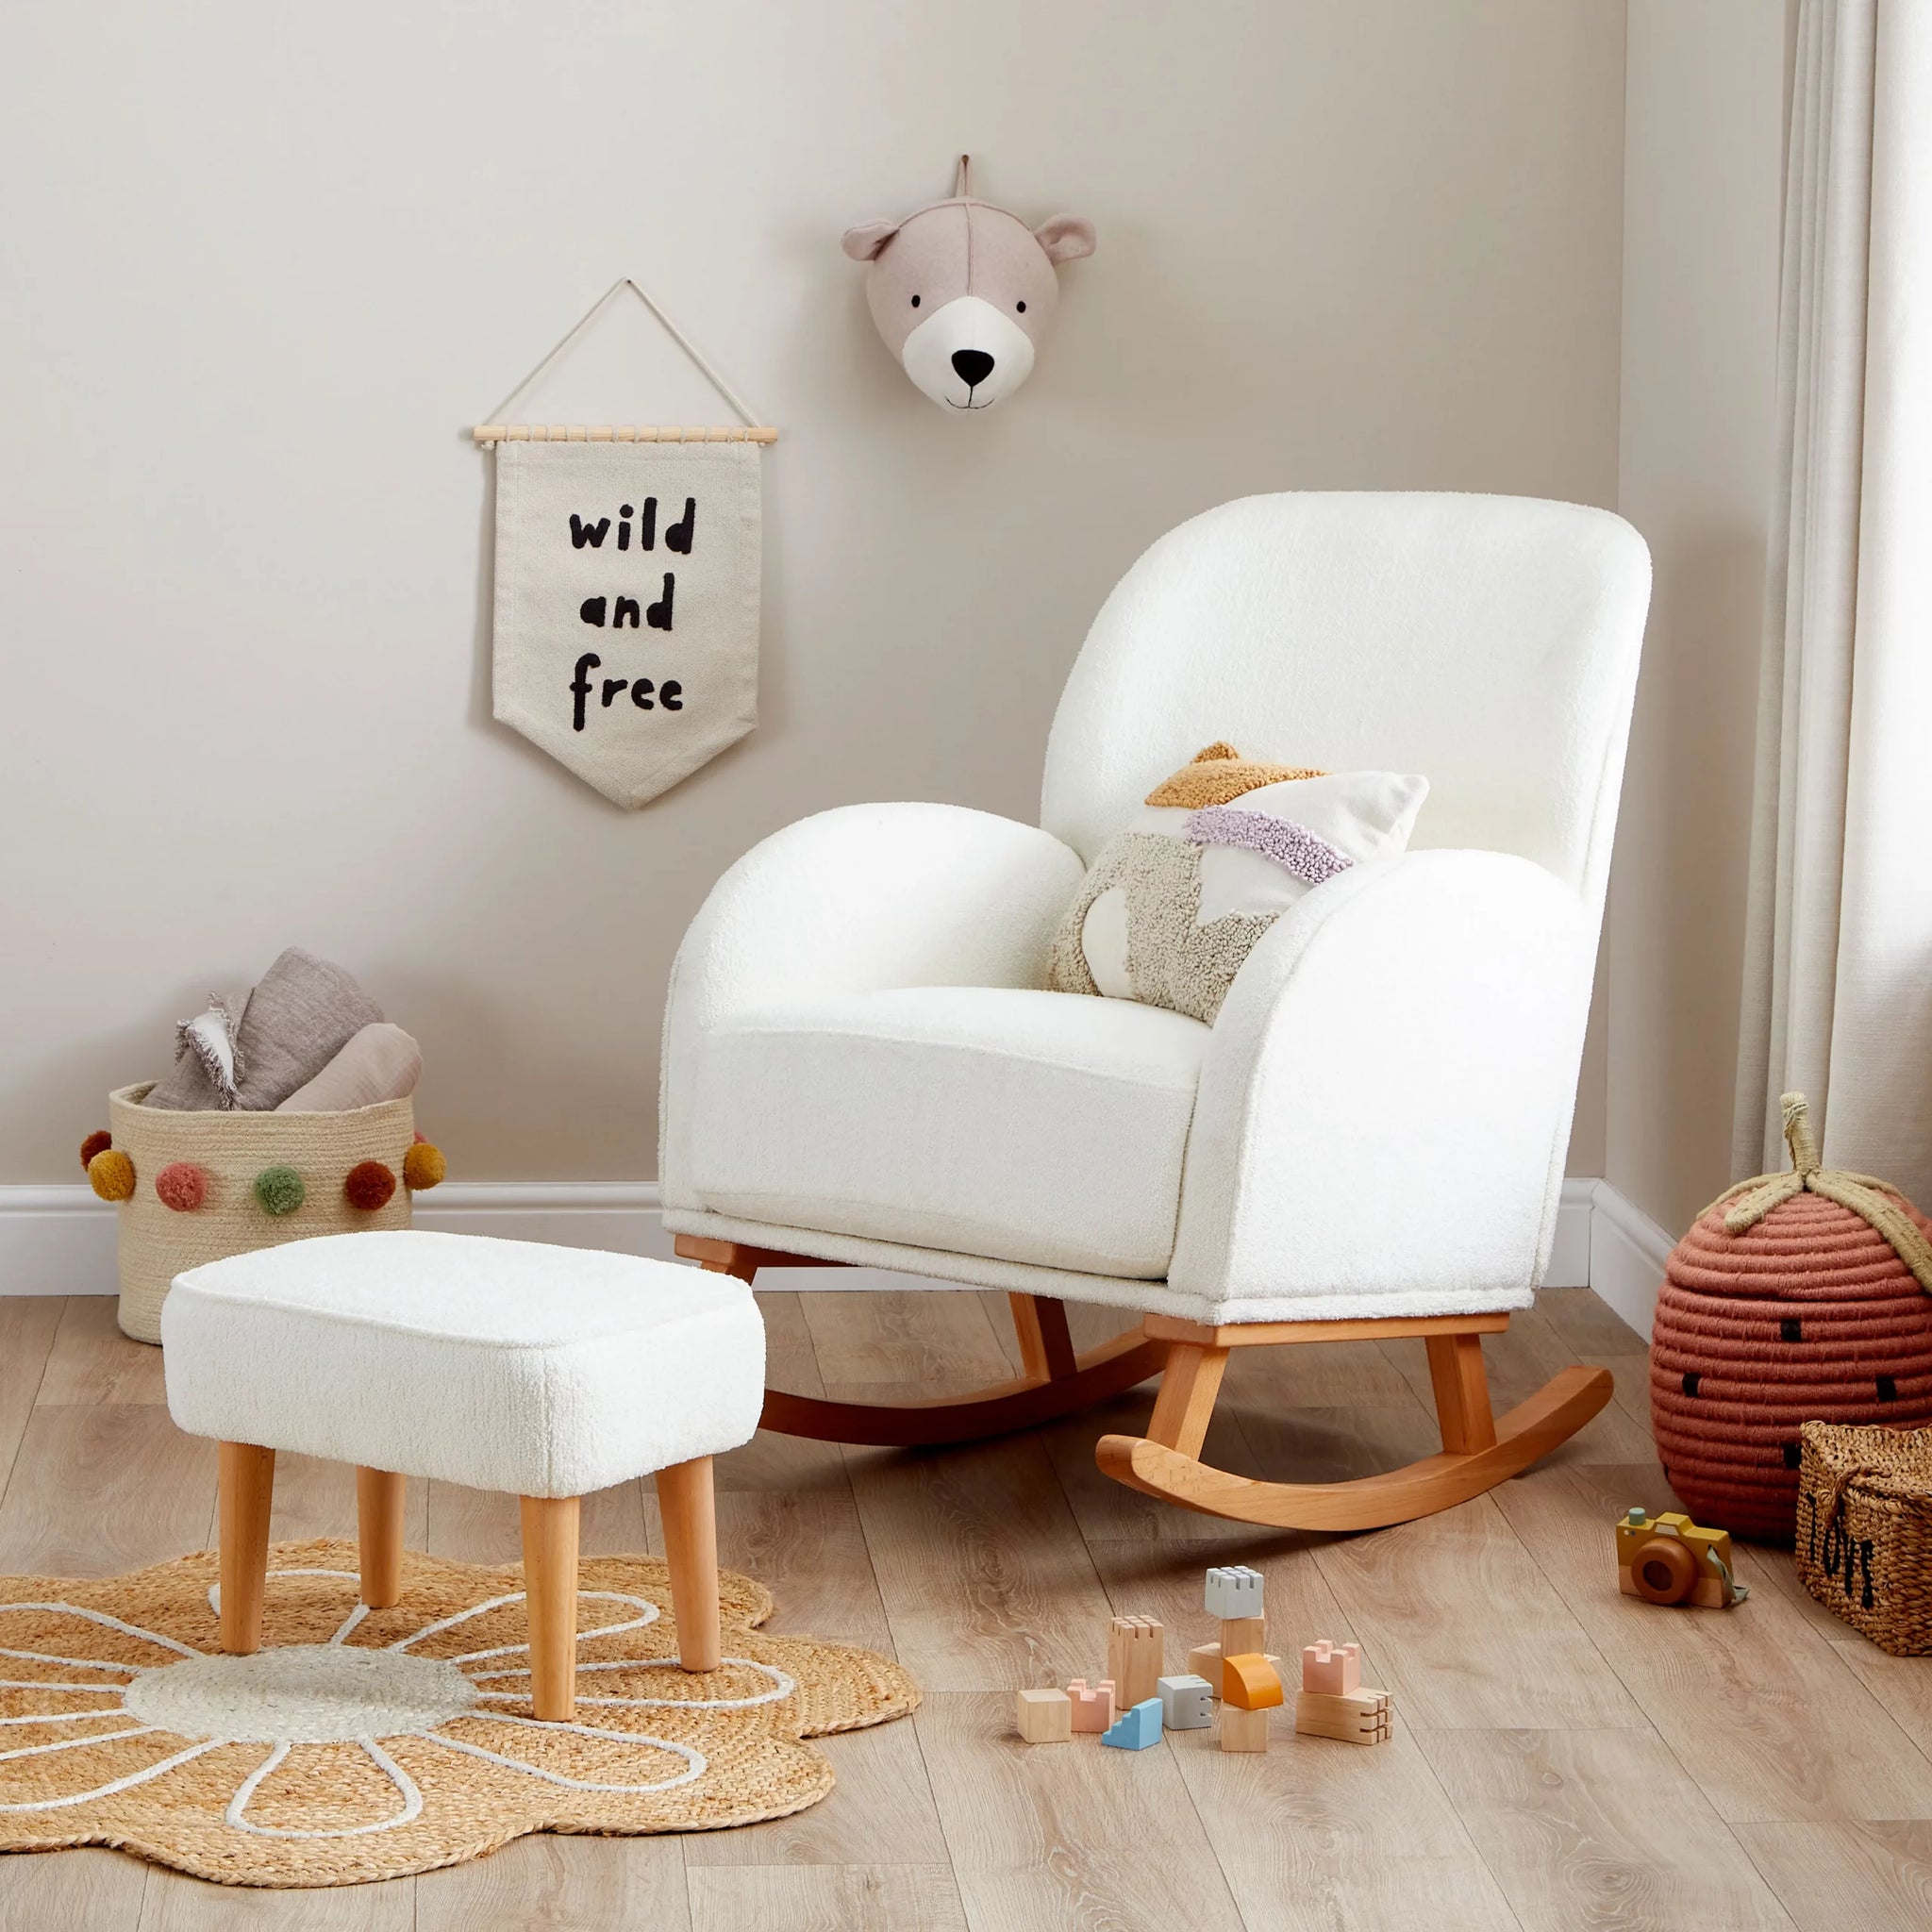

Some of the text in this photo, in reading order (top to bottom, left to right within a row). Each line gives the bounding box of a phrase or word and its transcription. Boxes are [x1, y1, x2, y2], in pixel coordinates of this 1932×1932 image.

[569, 496, 696, 556] wild
[579, 572, 675, 632] and
[569, 652, 684, 732] free
